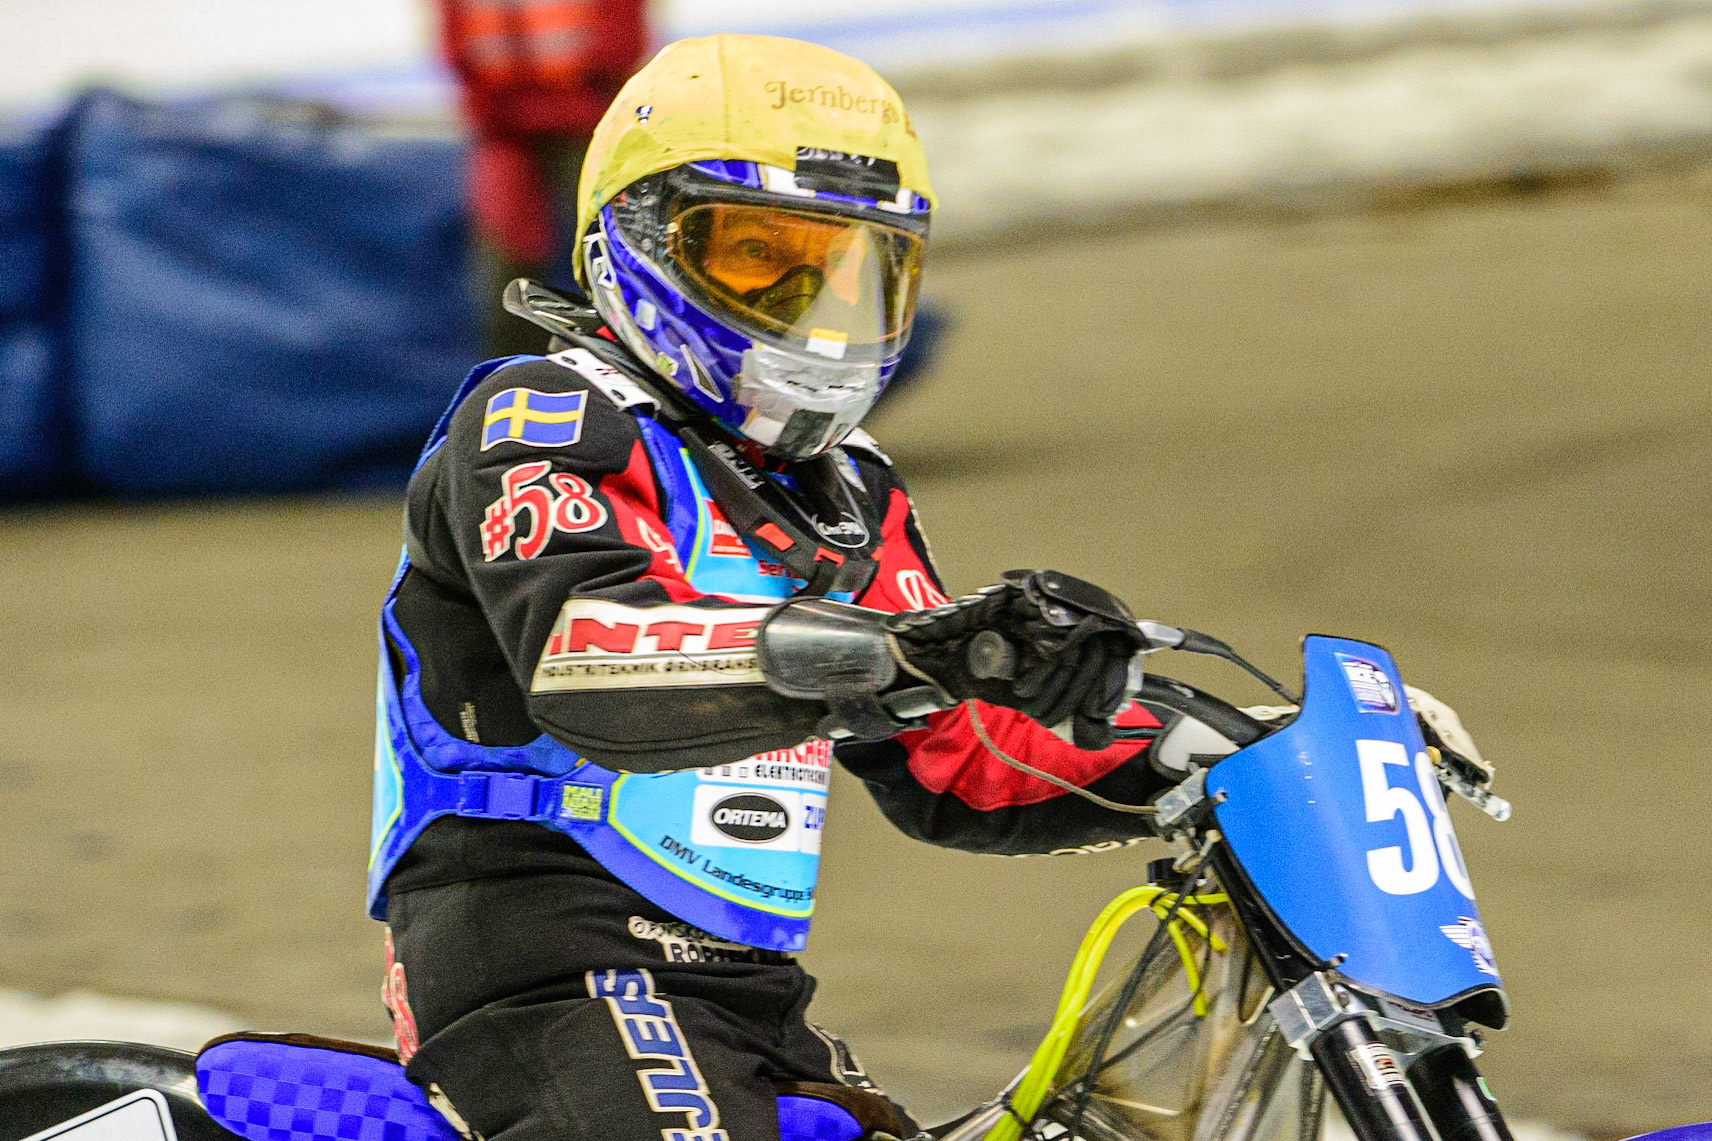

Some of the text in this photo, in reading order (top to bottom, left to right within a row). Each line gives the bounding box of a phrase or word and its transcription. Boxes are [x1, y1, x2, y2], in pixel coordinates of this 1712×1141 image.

[478, 459, 609, 563] #58
[713, 807, 787, 829] ORTEMA
[658, 835, 702, 865] DMV
